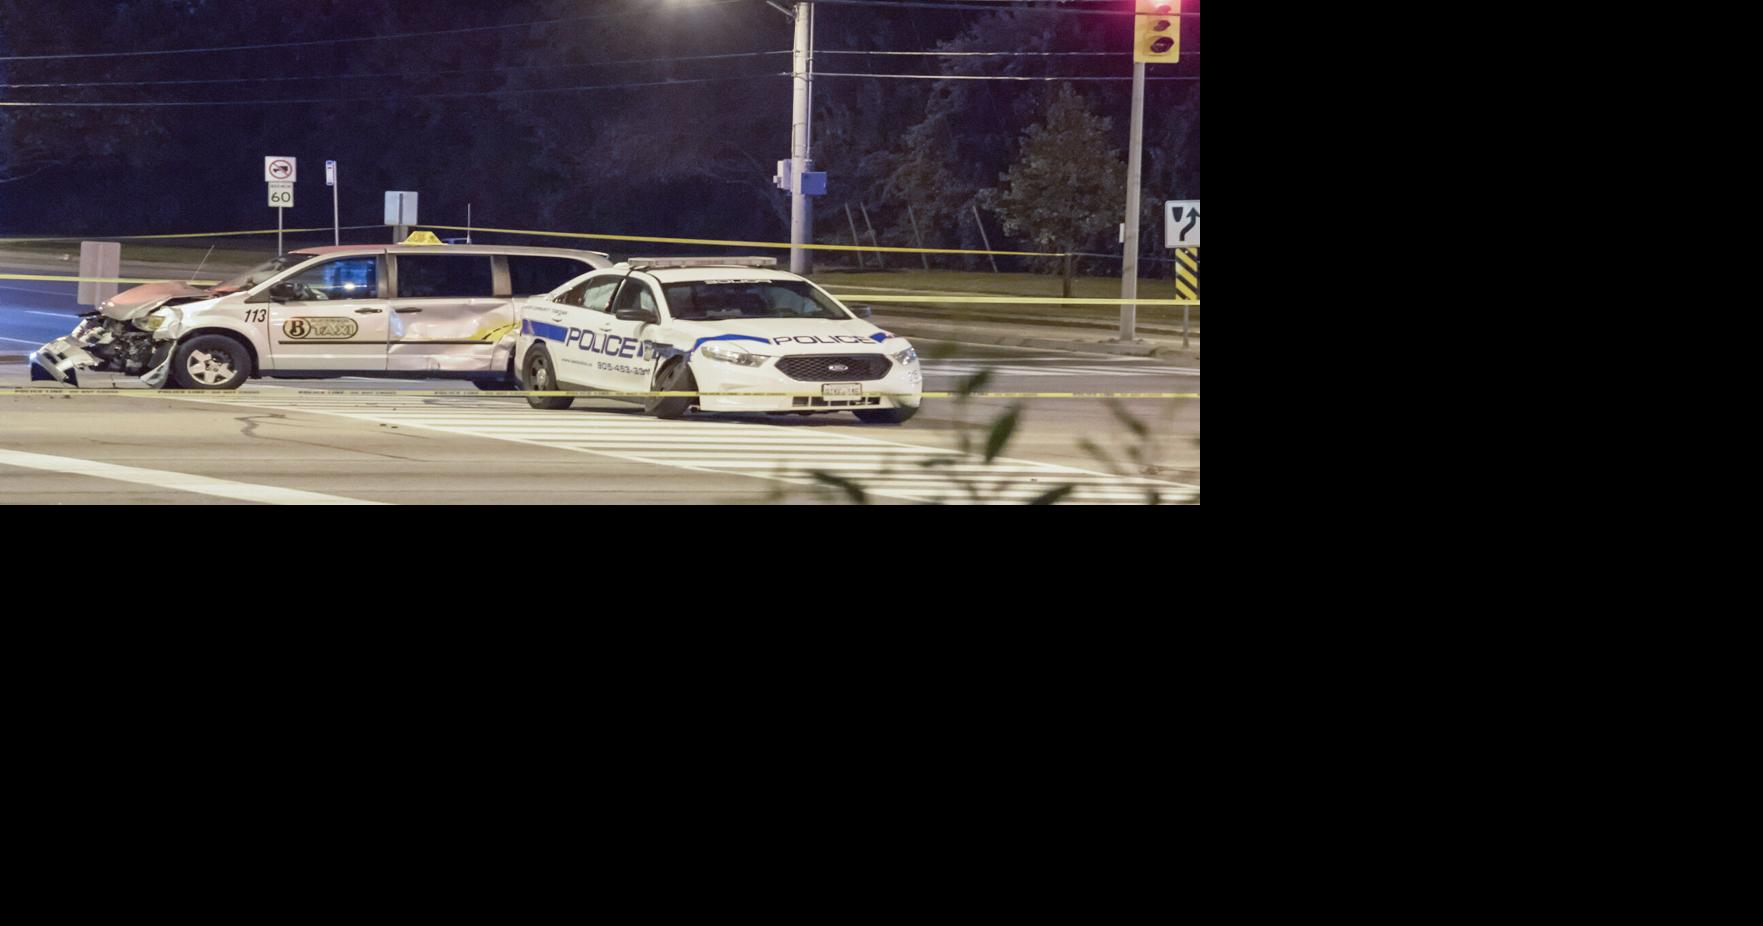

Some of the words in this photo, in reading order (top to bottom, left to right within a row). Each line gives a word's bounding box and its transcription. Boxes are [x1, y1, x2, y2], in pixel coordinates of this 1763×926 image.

[271, 191, 291, 203] 60
[244, 308, 267, 323] 113
[312, 323, 355, 337] TAXI
[566, 327, 639, 359] POLICE
[772, 335, 877, 346] POLICE
